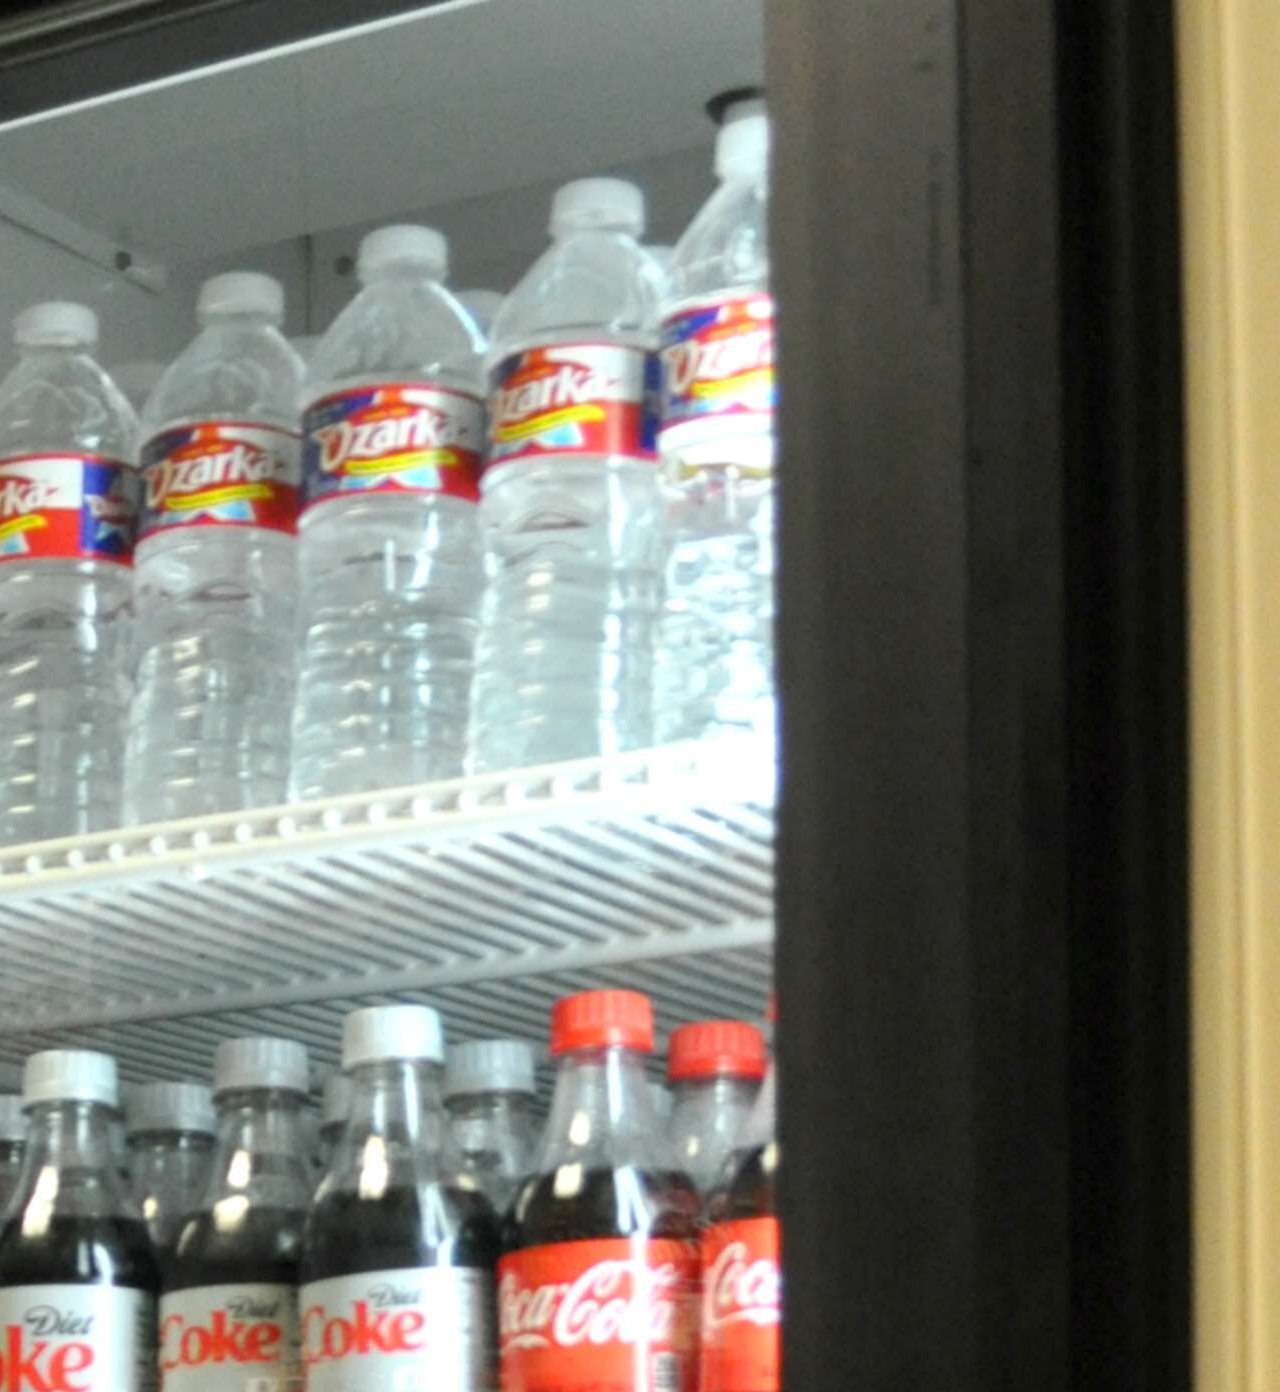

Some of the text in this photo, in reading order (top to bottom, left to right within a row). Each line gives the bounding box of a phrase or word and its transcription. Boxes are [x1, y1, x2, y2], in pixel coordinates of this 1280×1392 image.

[312, 408, 461, 472] Ozarka
[144, 445, 277, 508] Ozarka
[24, 1303, 95, 1336] Diet
[159, 1309, 283, 1371] Coke
[300, 1298, 427, 1364] Coke
